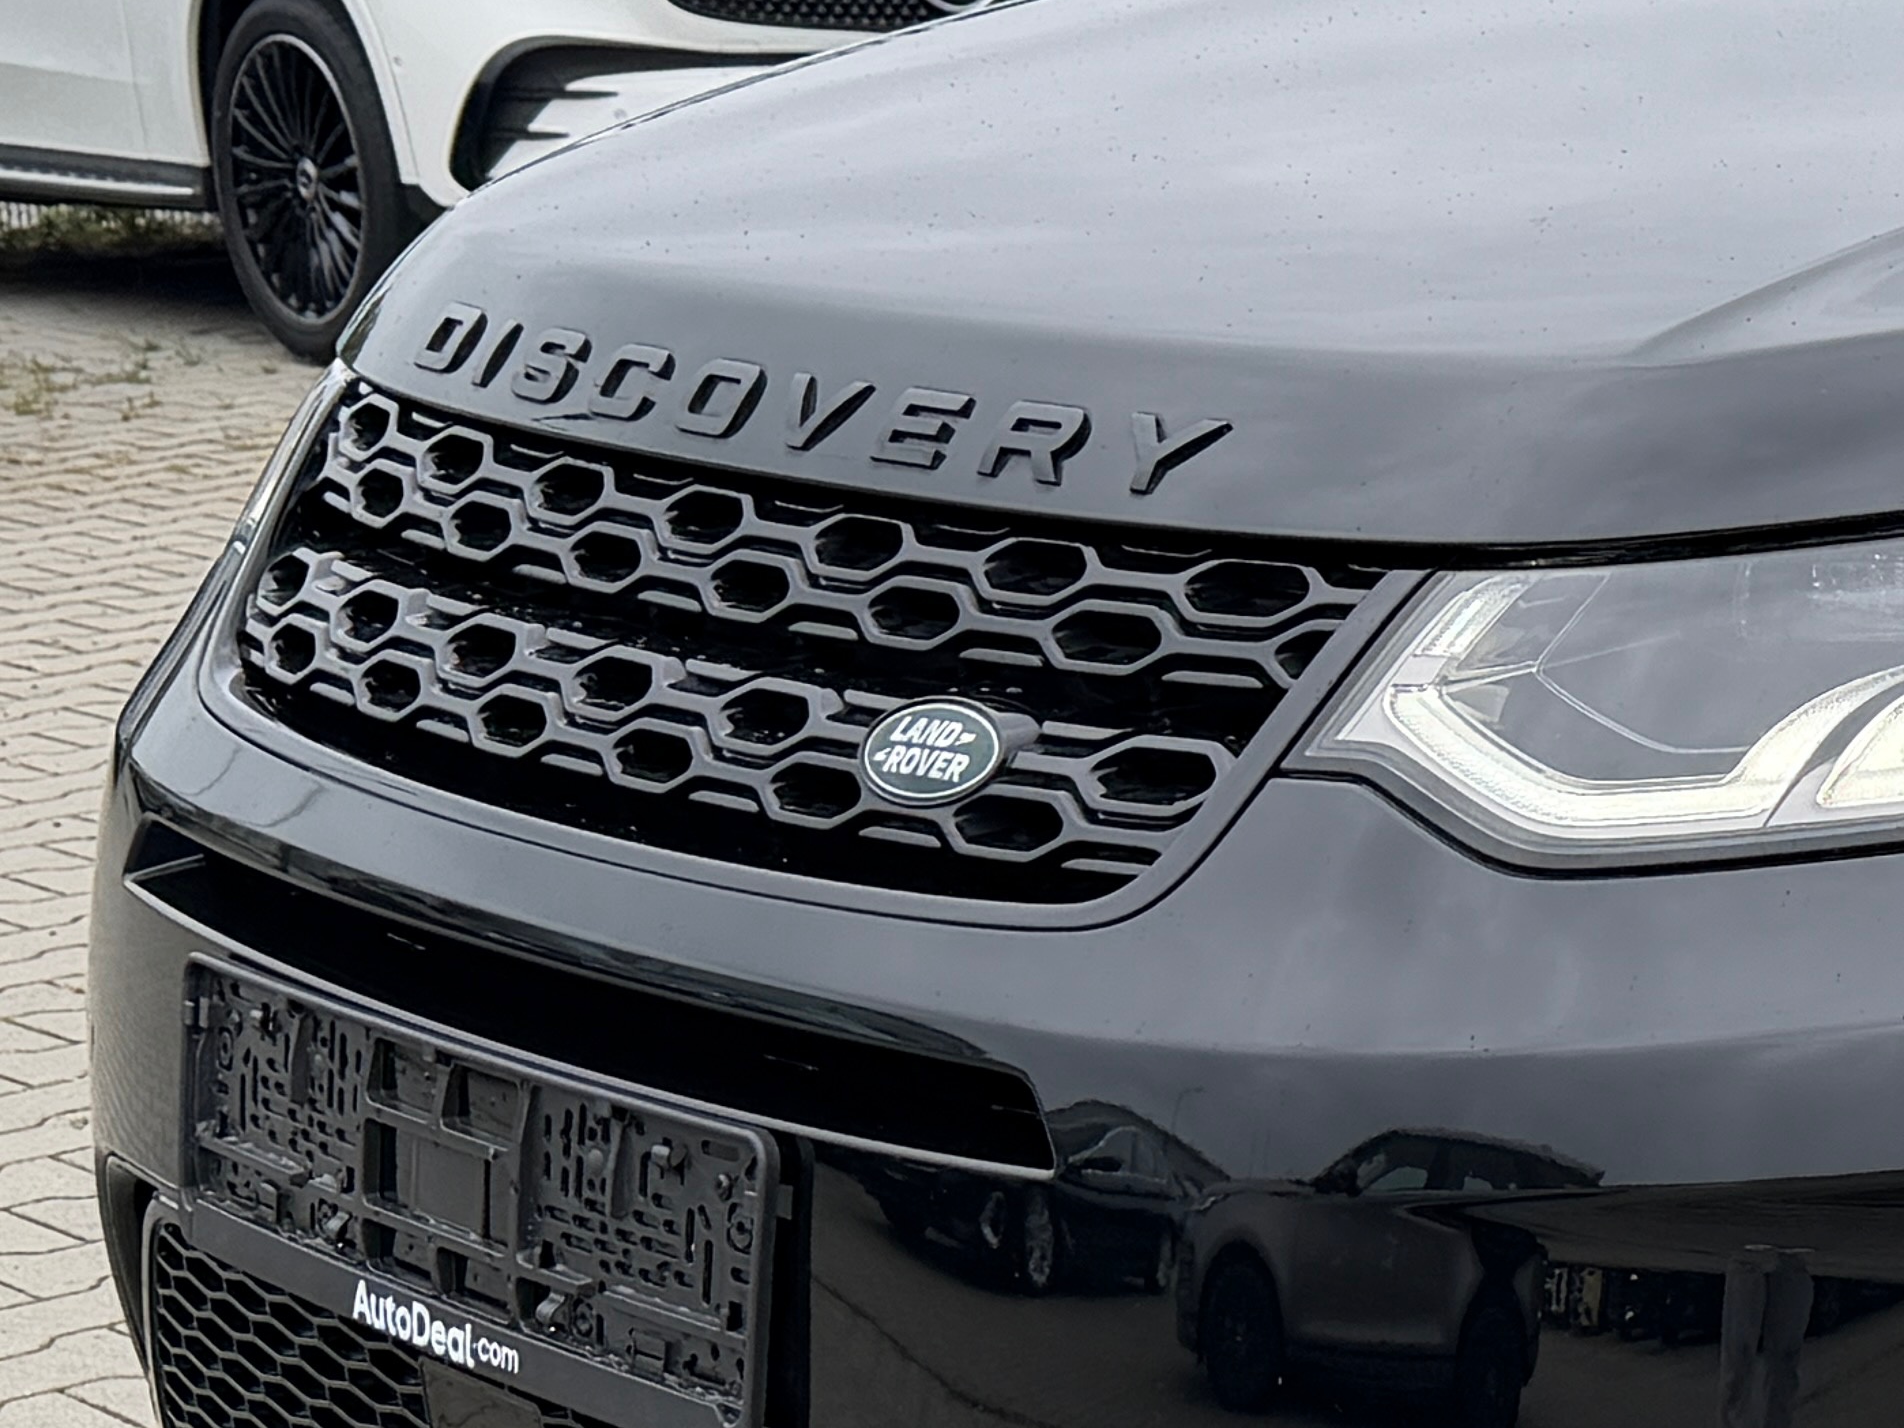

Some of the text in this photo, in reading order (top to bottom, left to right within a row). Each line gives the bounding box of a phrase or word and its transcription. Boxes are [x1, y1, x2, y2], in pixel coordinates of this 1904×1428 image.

[412, 300, 1234, 496] DISCOVERY
[889, 715, 964, 748] LAND
[881, 744, 971, 783] ROVER
